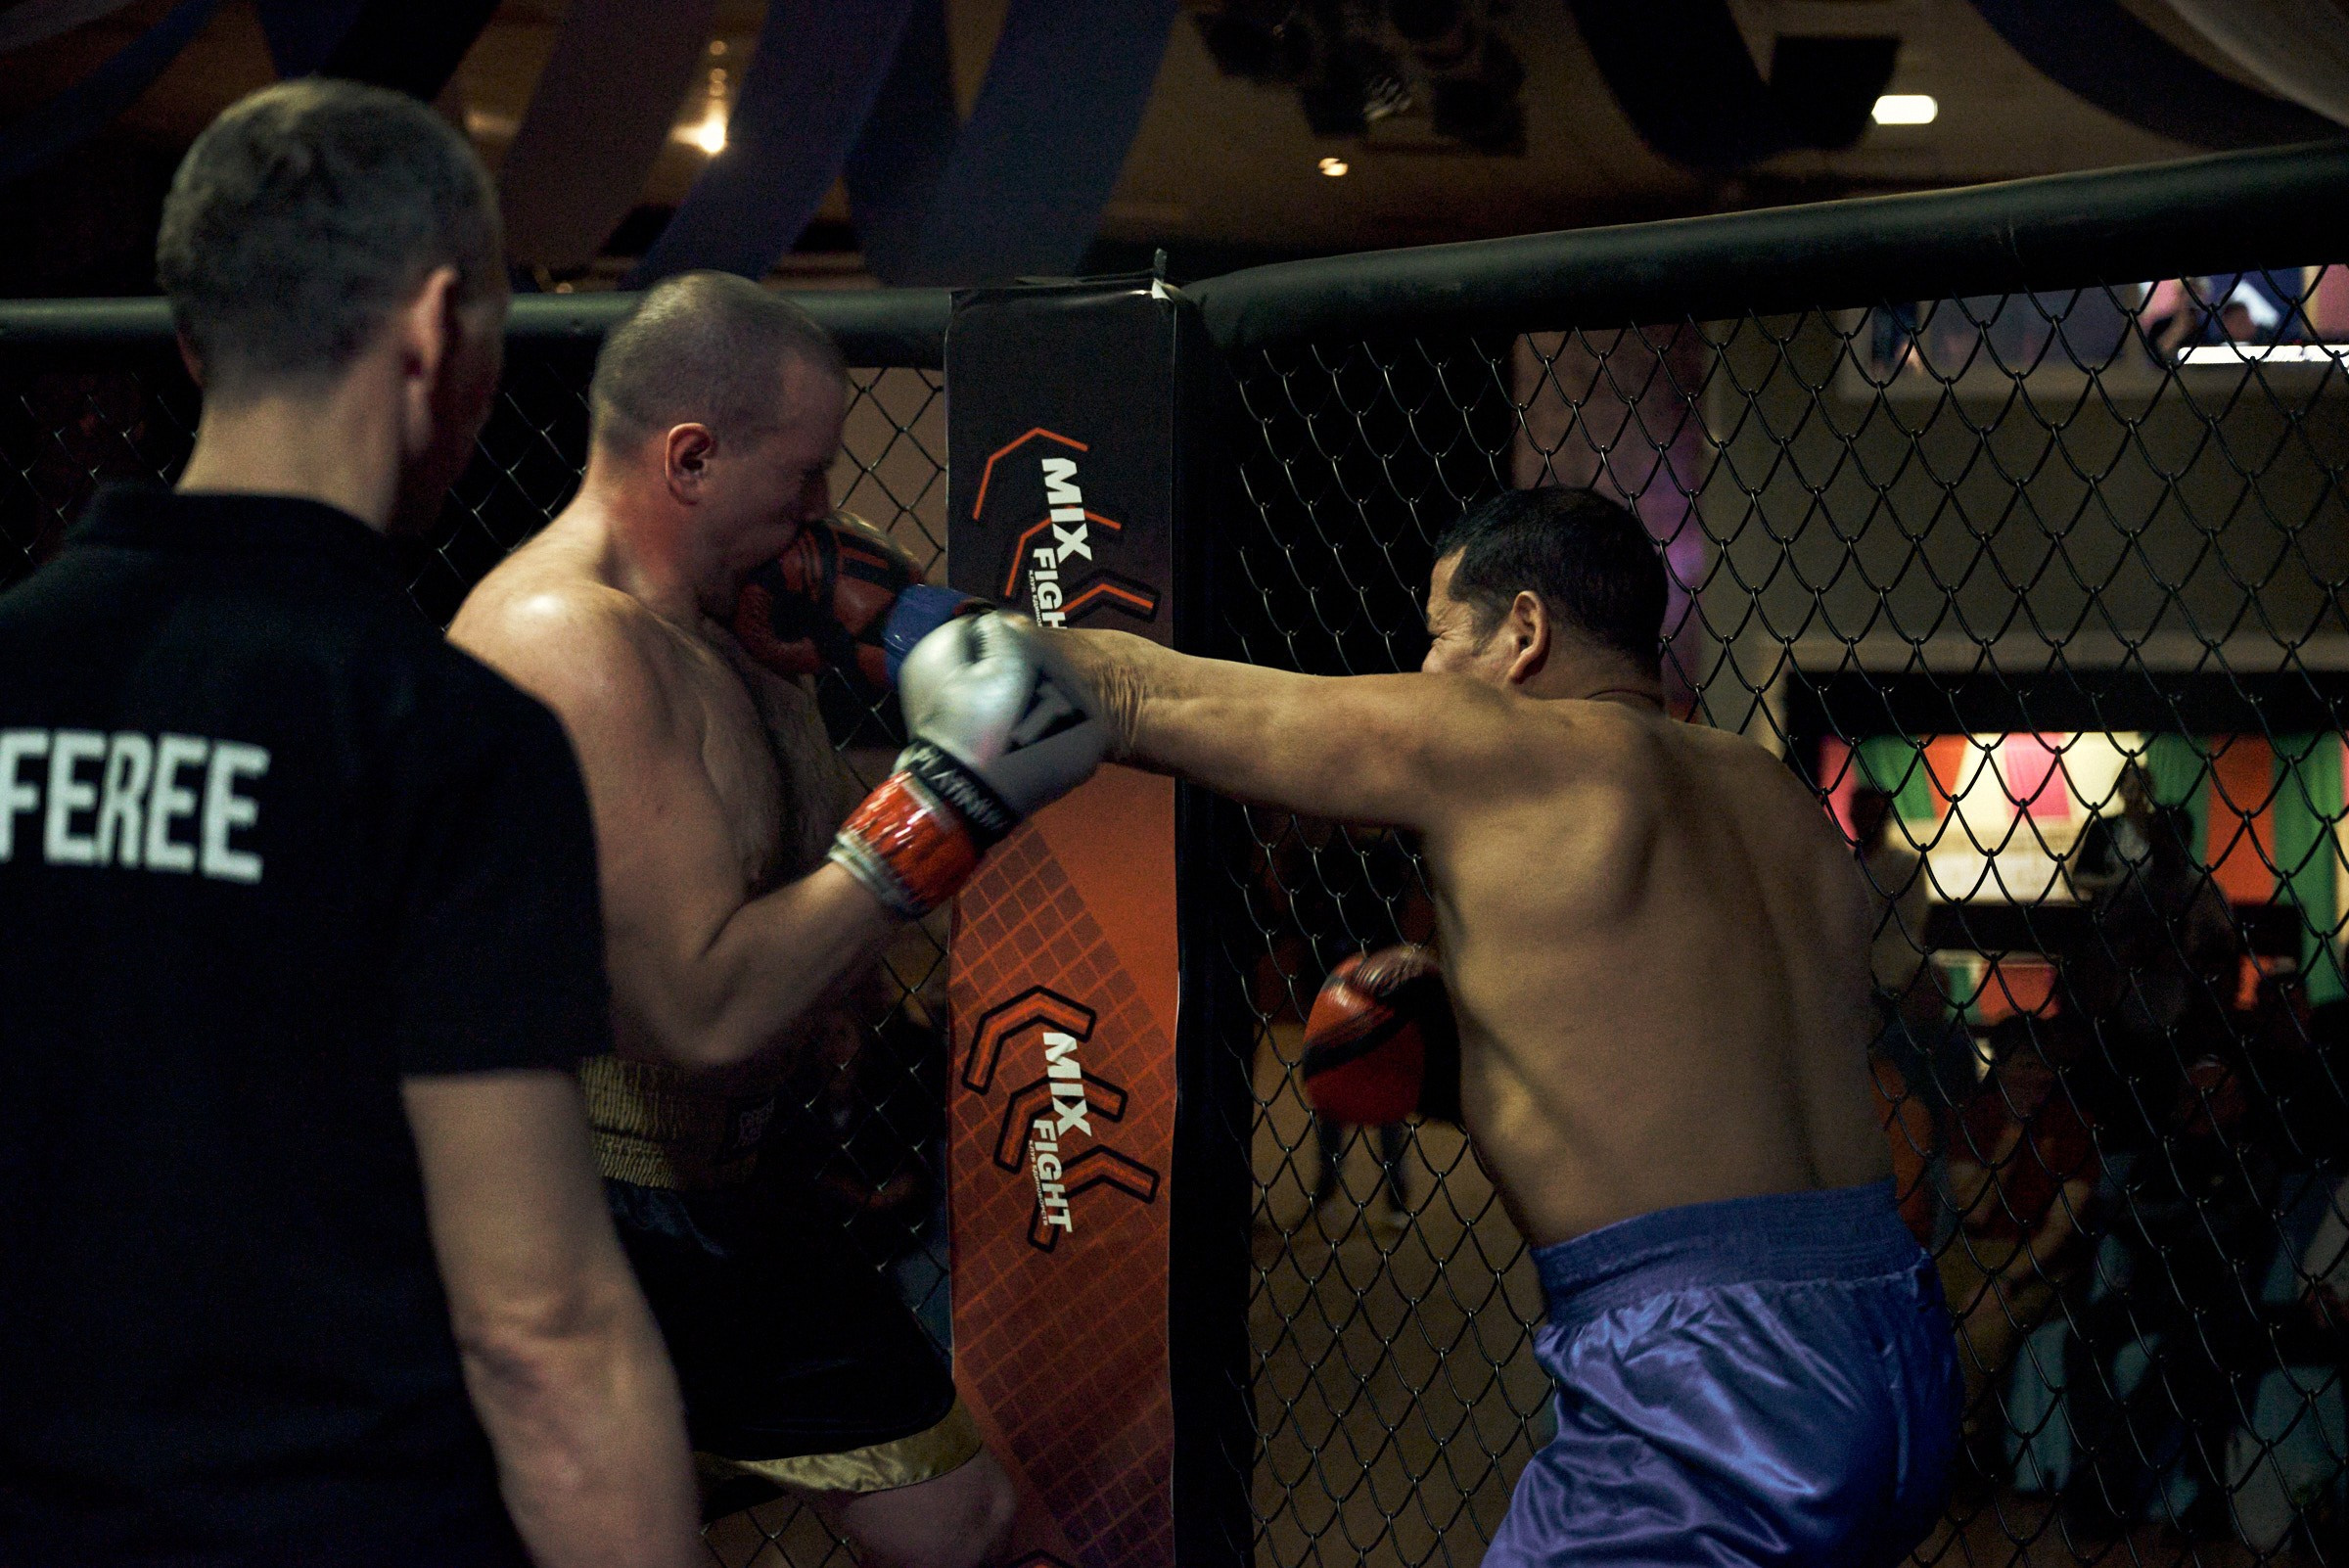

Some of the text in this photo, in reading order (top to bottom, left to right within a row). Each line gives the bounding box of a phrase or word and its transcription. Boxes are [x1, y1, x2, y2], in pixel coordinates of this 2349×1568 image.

[1041, 457, 1092, 564] MIX
[1033, 547, 1068, 628] FIGH
[0, 726, 272, 887] FEREE
[1042, 1032, 1092, 1137] MIX
[1033, 1119, 1074, 1233] FIGHT
